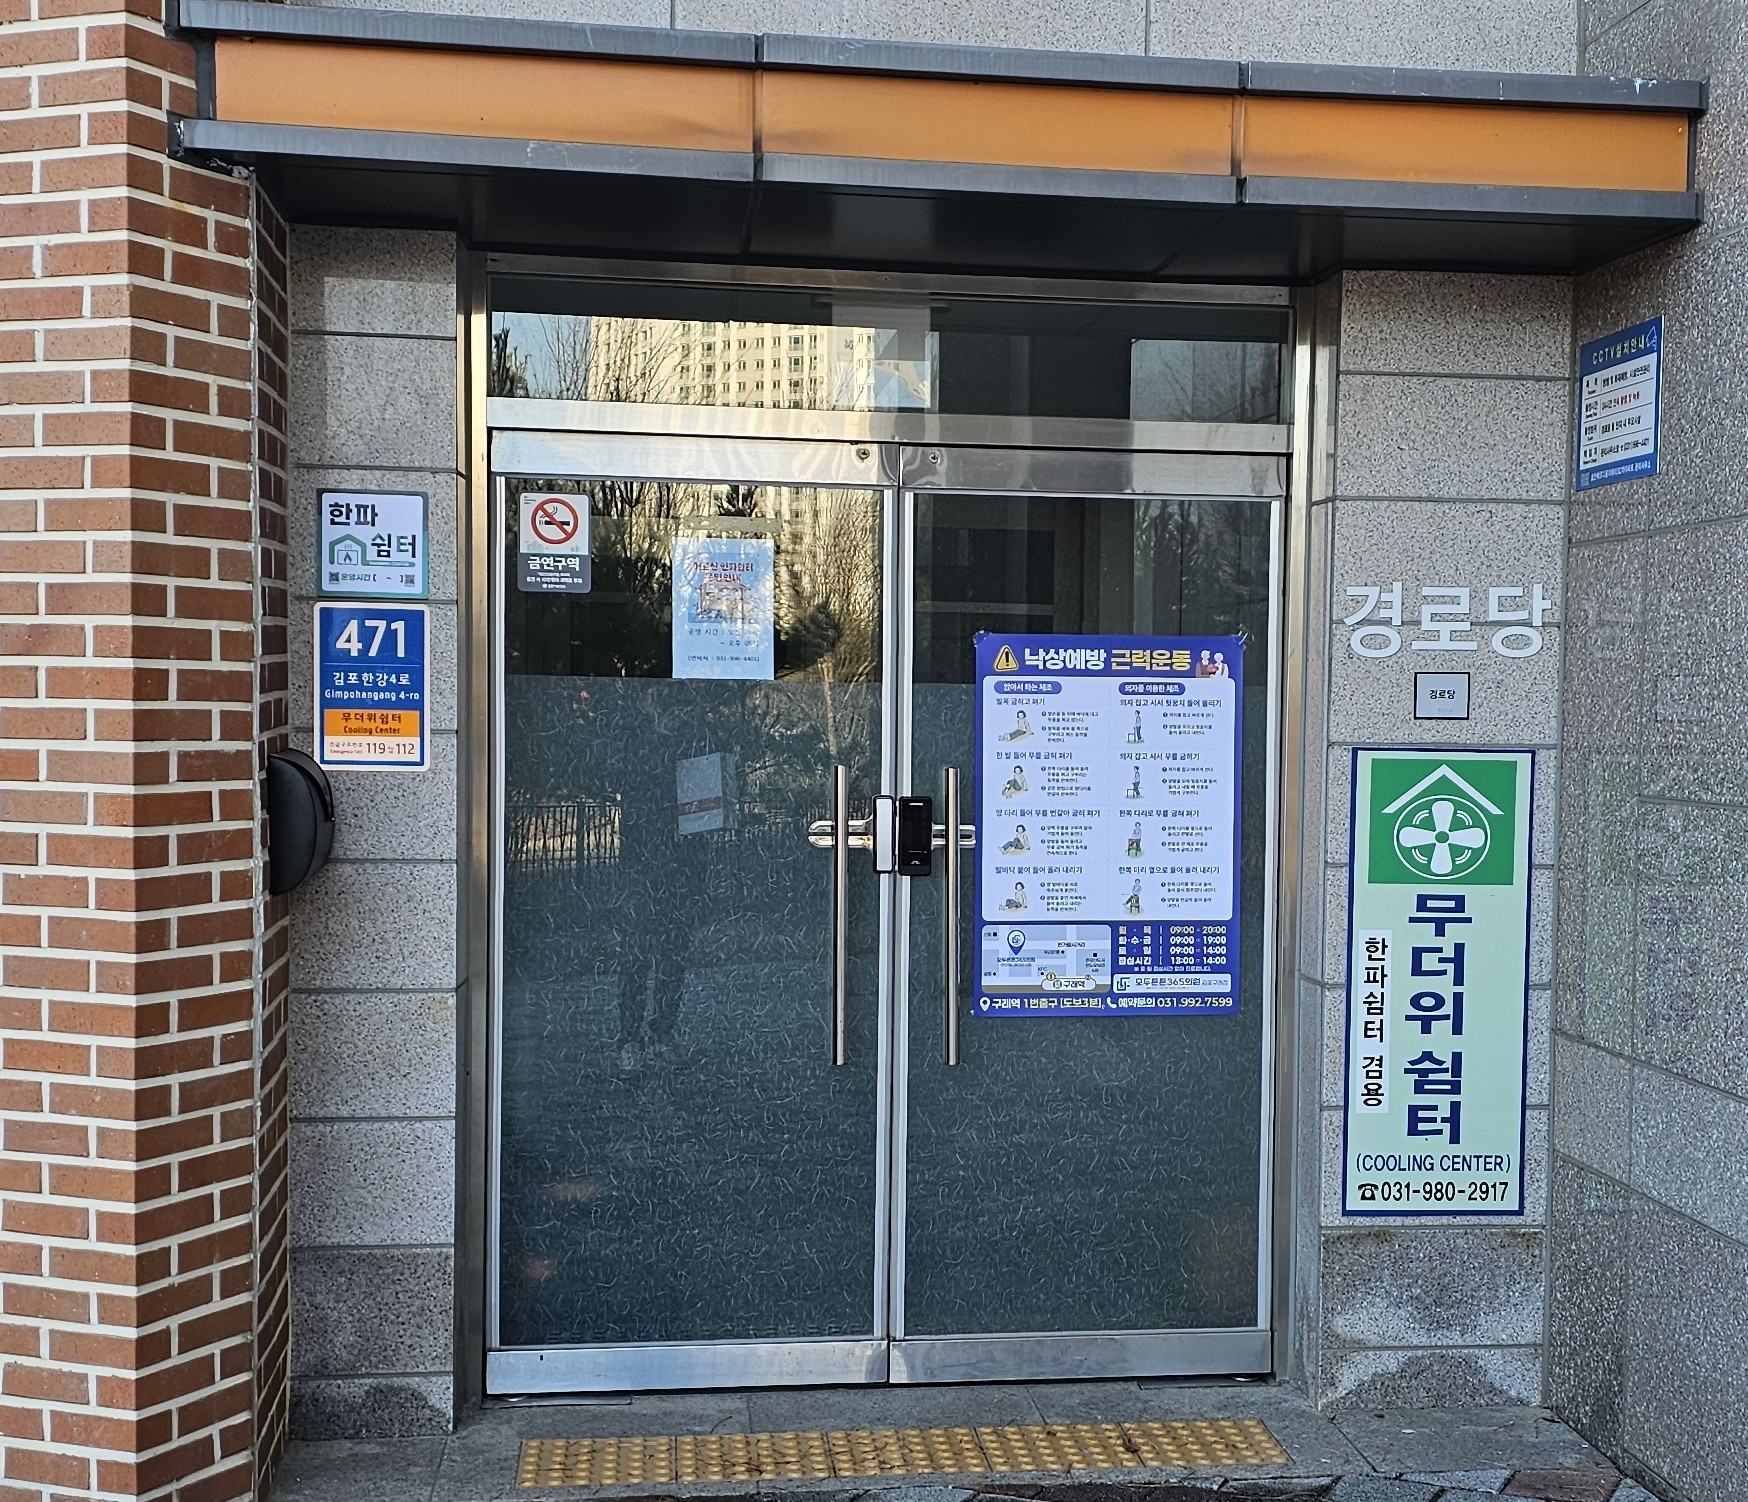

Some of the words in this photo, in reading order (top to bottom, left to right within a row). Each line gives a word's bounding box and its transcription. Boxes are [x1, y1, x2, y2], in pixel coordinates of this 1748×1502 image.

[1592, 334, 1645, 365] CCTV설치안내
[328, 501, 379, 527] 한파
[371, 533, 416, 558] 쉼터
[528, 556, 580, 571] 금연구역
[1343, 582, 1552, 658] 경로당
[335, 620, 405, 658] 471
[1024, 648, 1107, 671] 낙상예방
[1110, 649, 1192, 672] 근력운동
[332, 671, 411, 687] 김포한강4로
[324, 689, 397, 702] Gimpohangang
[398, 690, 420, 700] 4-ro
[1429, 689, 1456, 700] 경로당
[340, 712, 402, 725] 무더위쉼터
[344, 725, 373, 736] Cooling
[375, 726, 401, 735] Center
[366, 742, 386, 754] 119
[395, 743, 415, 755] 112
[1169, 925, 1195, 934] 09:00
[1201, 925, 1227, 934] 20:00
[1169, 936, 1195, 944] 09:00
[1202, 936, 1227, 944] 19:00
[1169, 946, 1195, 955] 09:00
[1202, 946, 1227, 955] 14:00
[1118, 957, 1152, 965] 점심시간
[1170, 956, 1195, 965] 13:00
[1202, 956, 1227, 965] 14:00
[1362, 938, 1388, 1044] 한파쉼터
[992, 998, 1021, 1009] 구래역
[1118, 997, 1156, 1008] 예약문의
[1156, 997, 1233, 1008] 031.992.7599
[1360, 1055, 1386, 1108] 겸용
[1356, 1153, 1434, 1173] (COOLING
[1439, 1153, 1511, 1174] CENTER)
